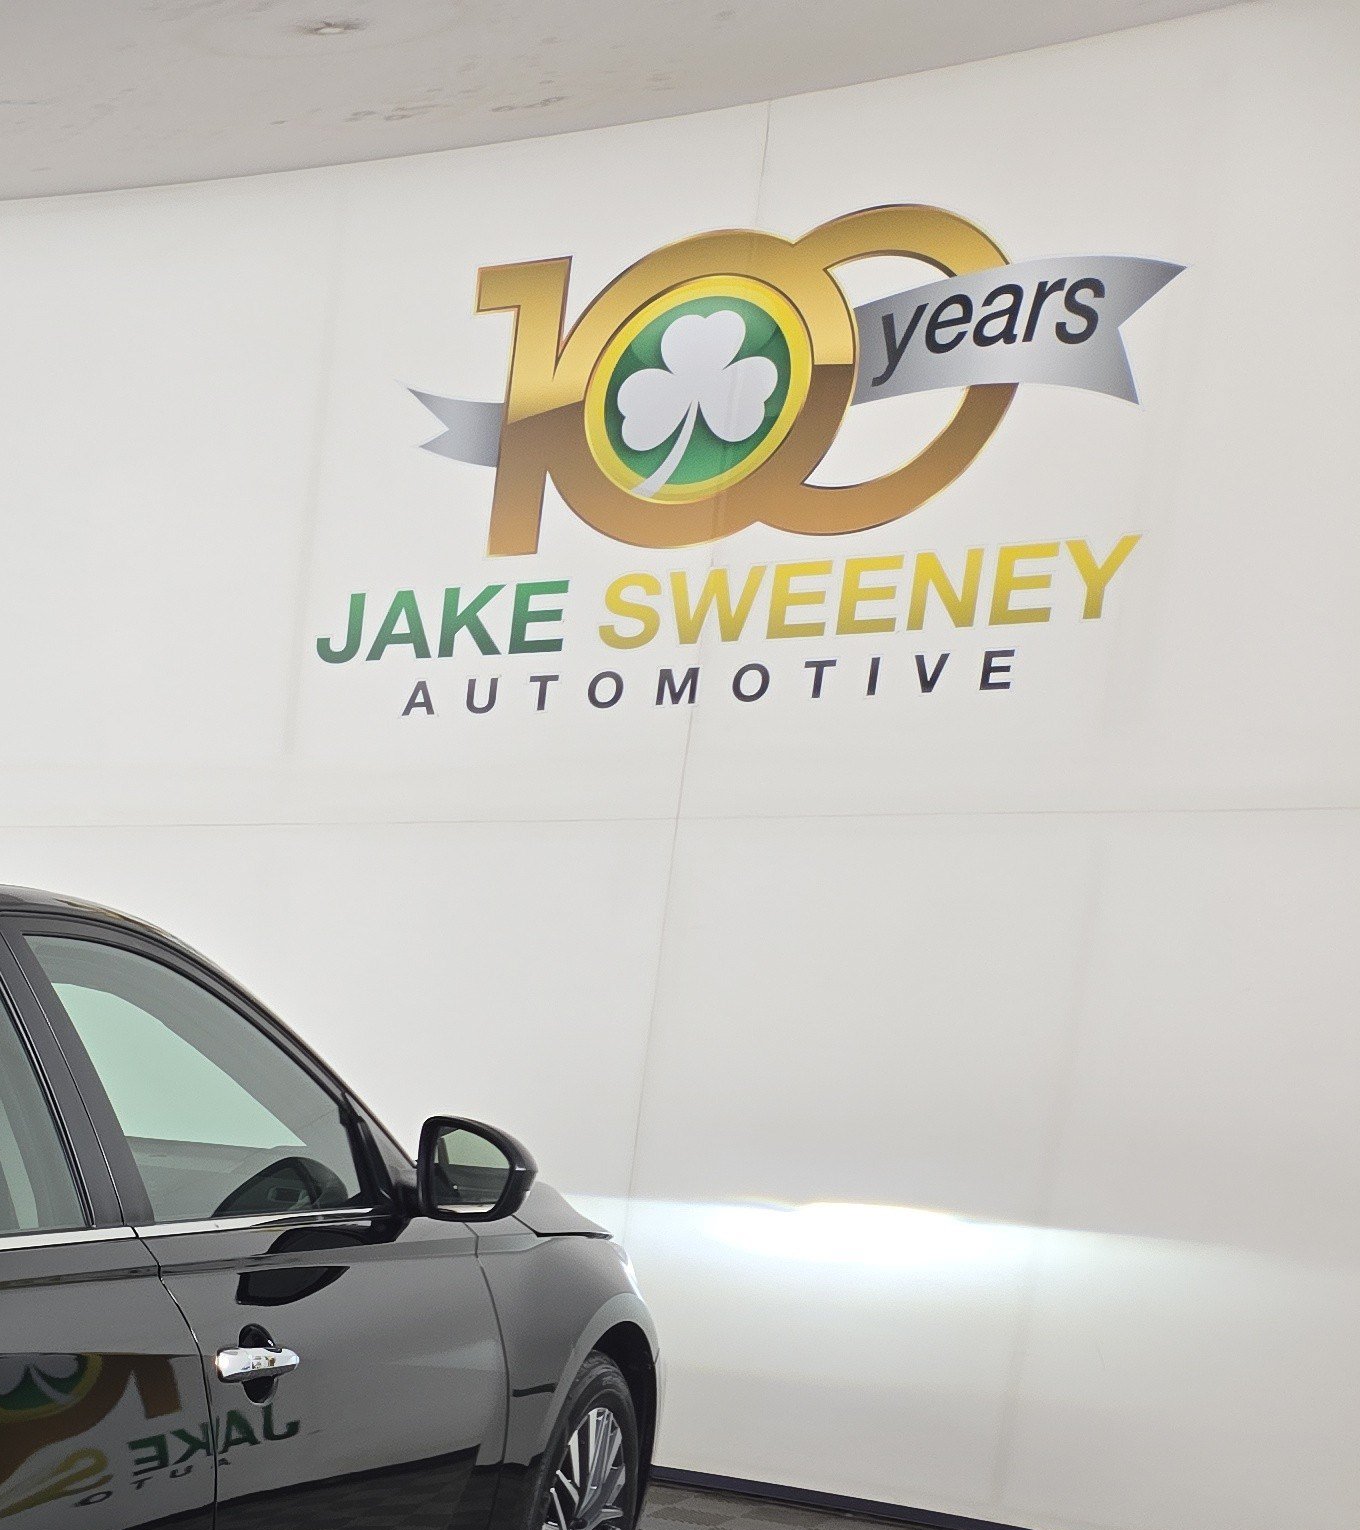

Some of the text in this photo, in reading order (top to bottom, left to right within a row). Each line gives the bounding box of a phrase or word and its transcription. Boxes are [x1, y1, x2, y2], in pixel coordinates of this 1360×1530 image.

[872, 275, 1106, 387] years
[315, 533, 1142, 665] JAKE SWEENEY
[401, 648, 1016, 718] AUTOMOTIVE
